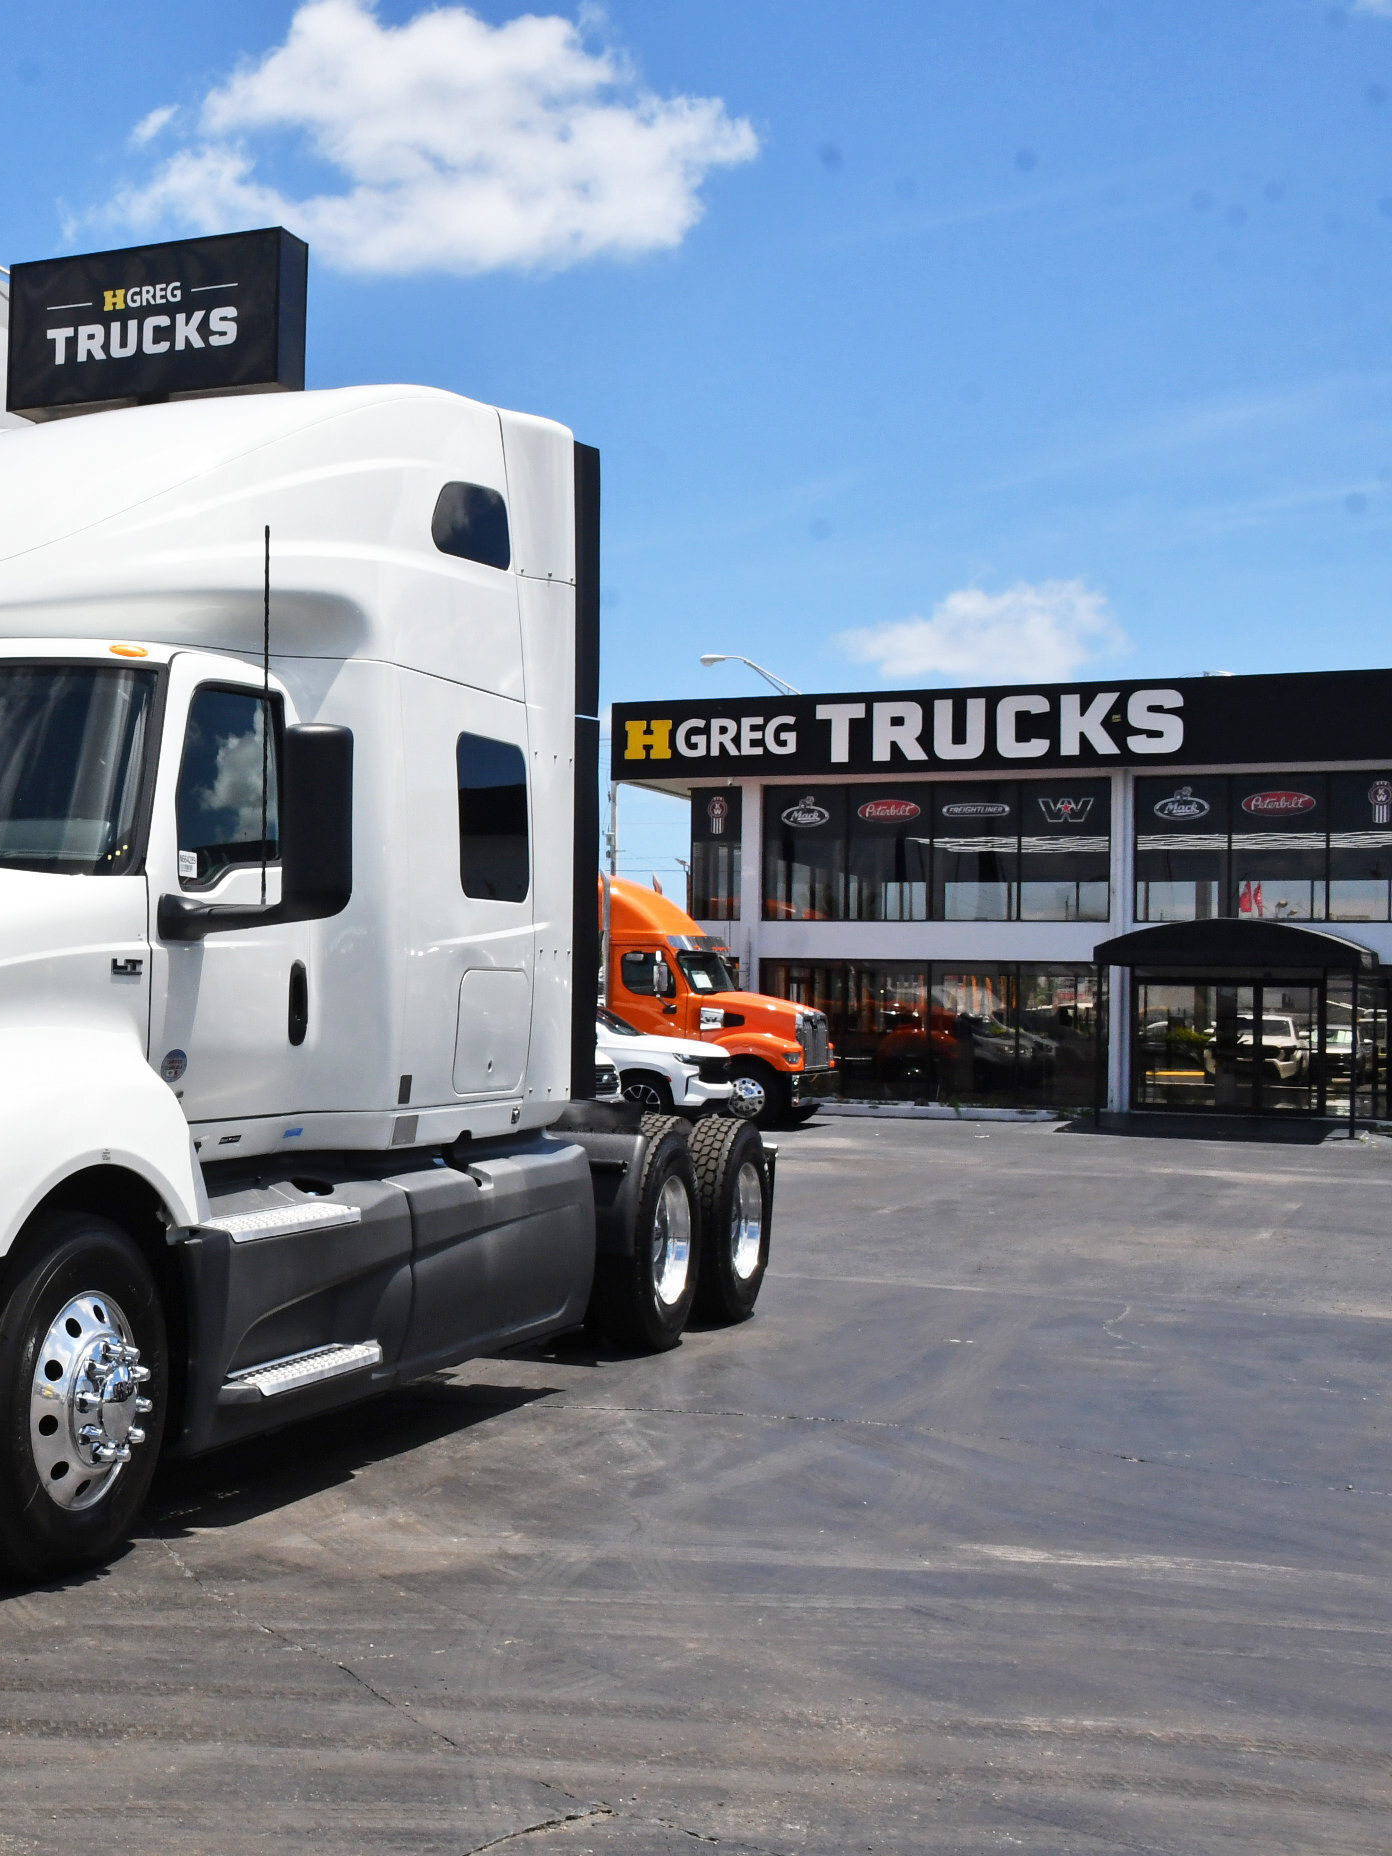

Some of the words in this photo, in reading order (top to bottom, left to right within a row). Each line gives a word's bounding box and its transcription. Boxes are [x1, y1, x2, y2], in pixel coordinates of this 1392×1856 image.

[103, 281, 182, 311] HGREG
[46, 305, 239, 366] TRUCKS
[815, 688, 1185, 763] TRUCKS
[864, 803, 916, 818] Peterbilt
[948, 806, 1004, 815] FREIGHTLINER
[1163, 801, 1200, 816] Mack
[1250, 795, 1309, 811] Peterbilt
[789, 810, 821, 822] Mack
[111, 958, 144, 974] LT
